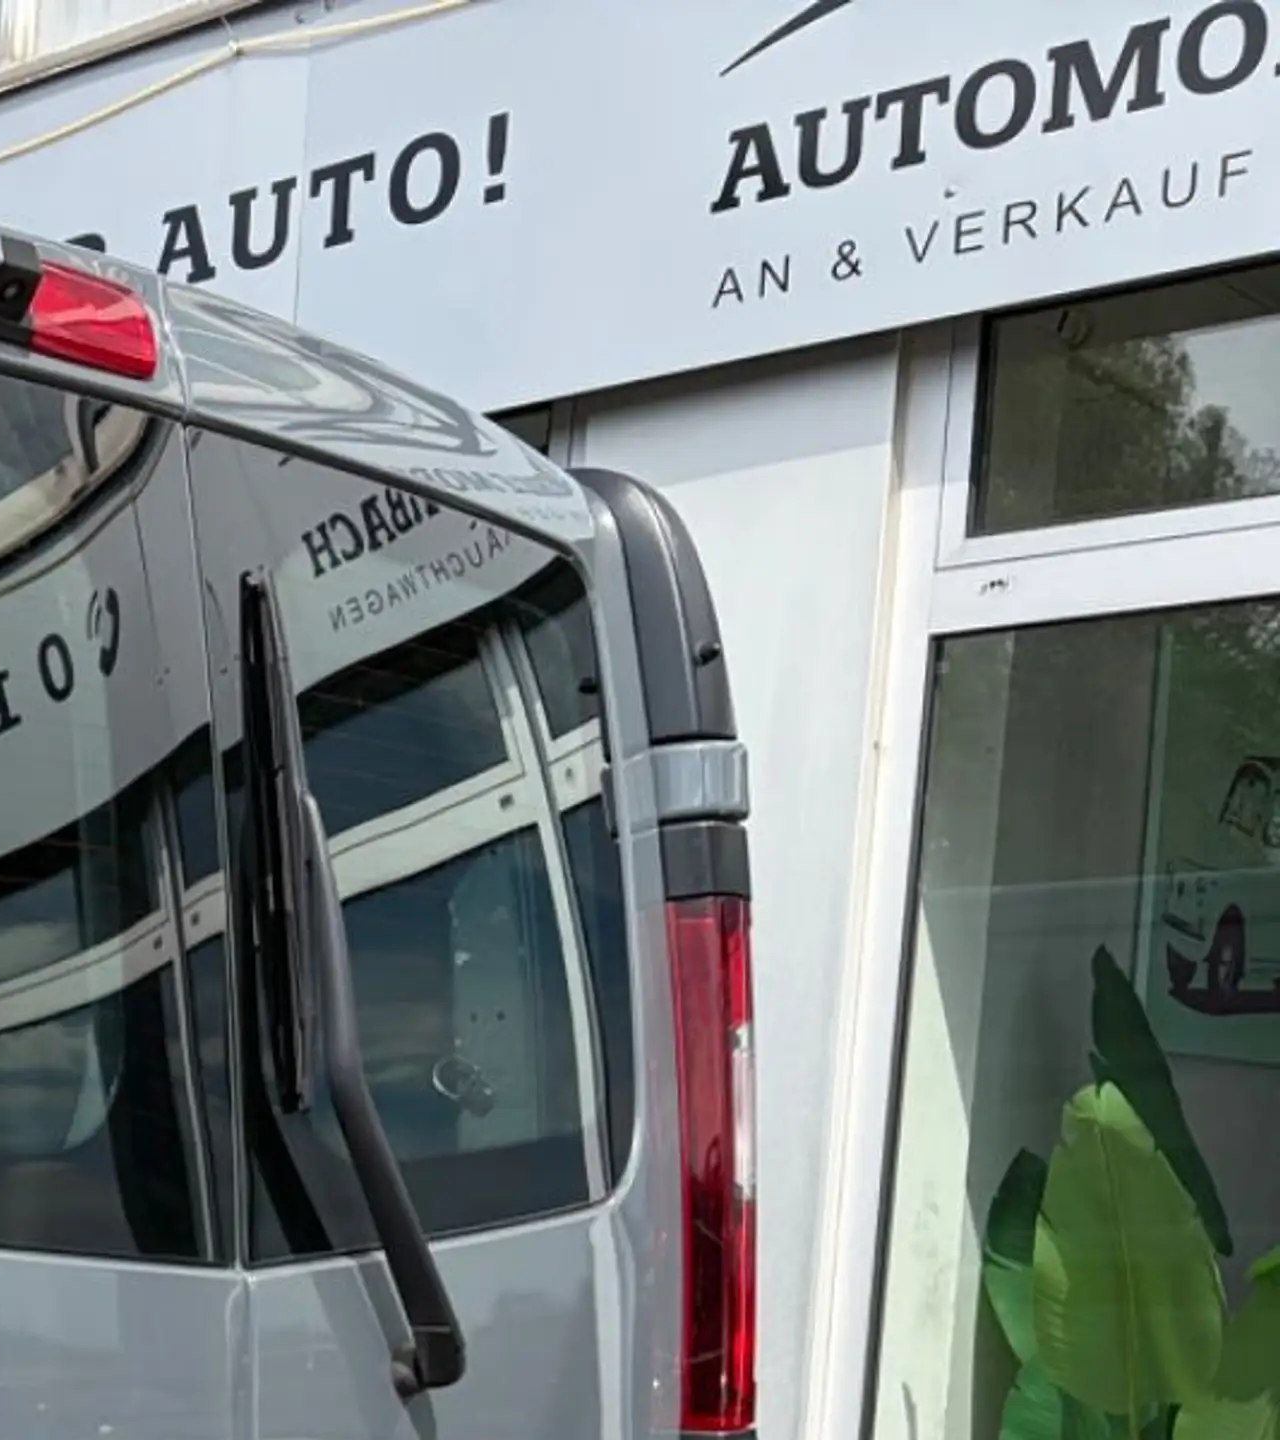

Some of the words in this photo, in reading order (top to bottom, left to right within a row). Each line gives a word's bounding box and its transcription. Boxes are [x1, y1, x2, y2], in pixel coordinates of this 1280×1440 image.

[709, 0, 1280, 214] AUTOMO
[157, 111, 509, 284] AUTO!
[711, 254, 793, 309] AN
[830, 239, 863, 281] &
[905, 149, 1254, 264] VERKAUF
